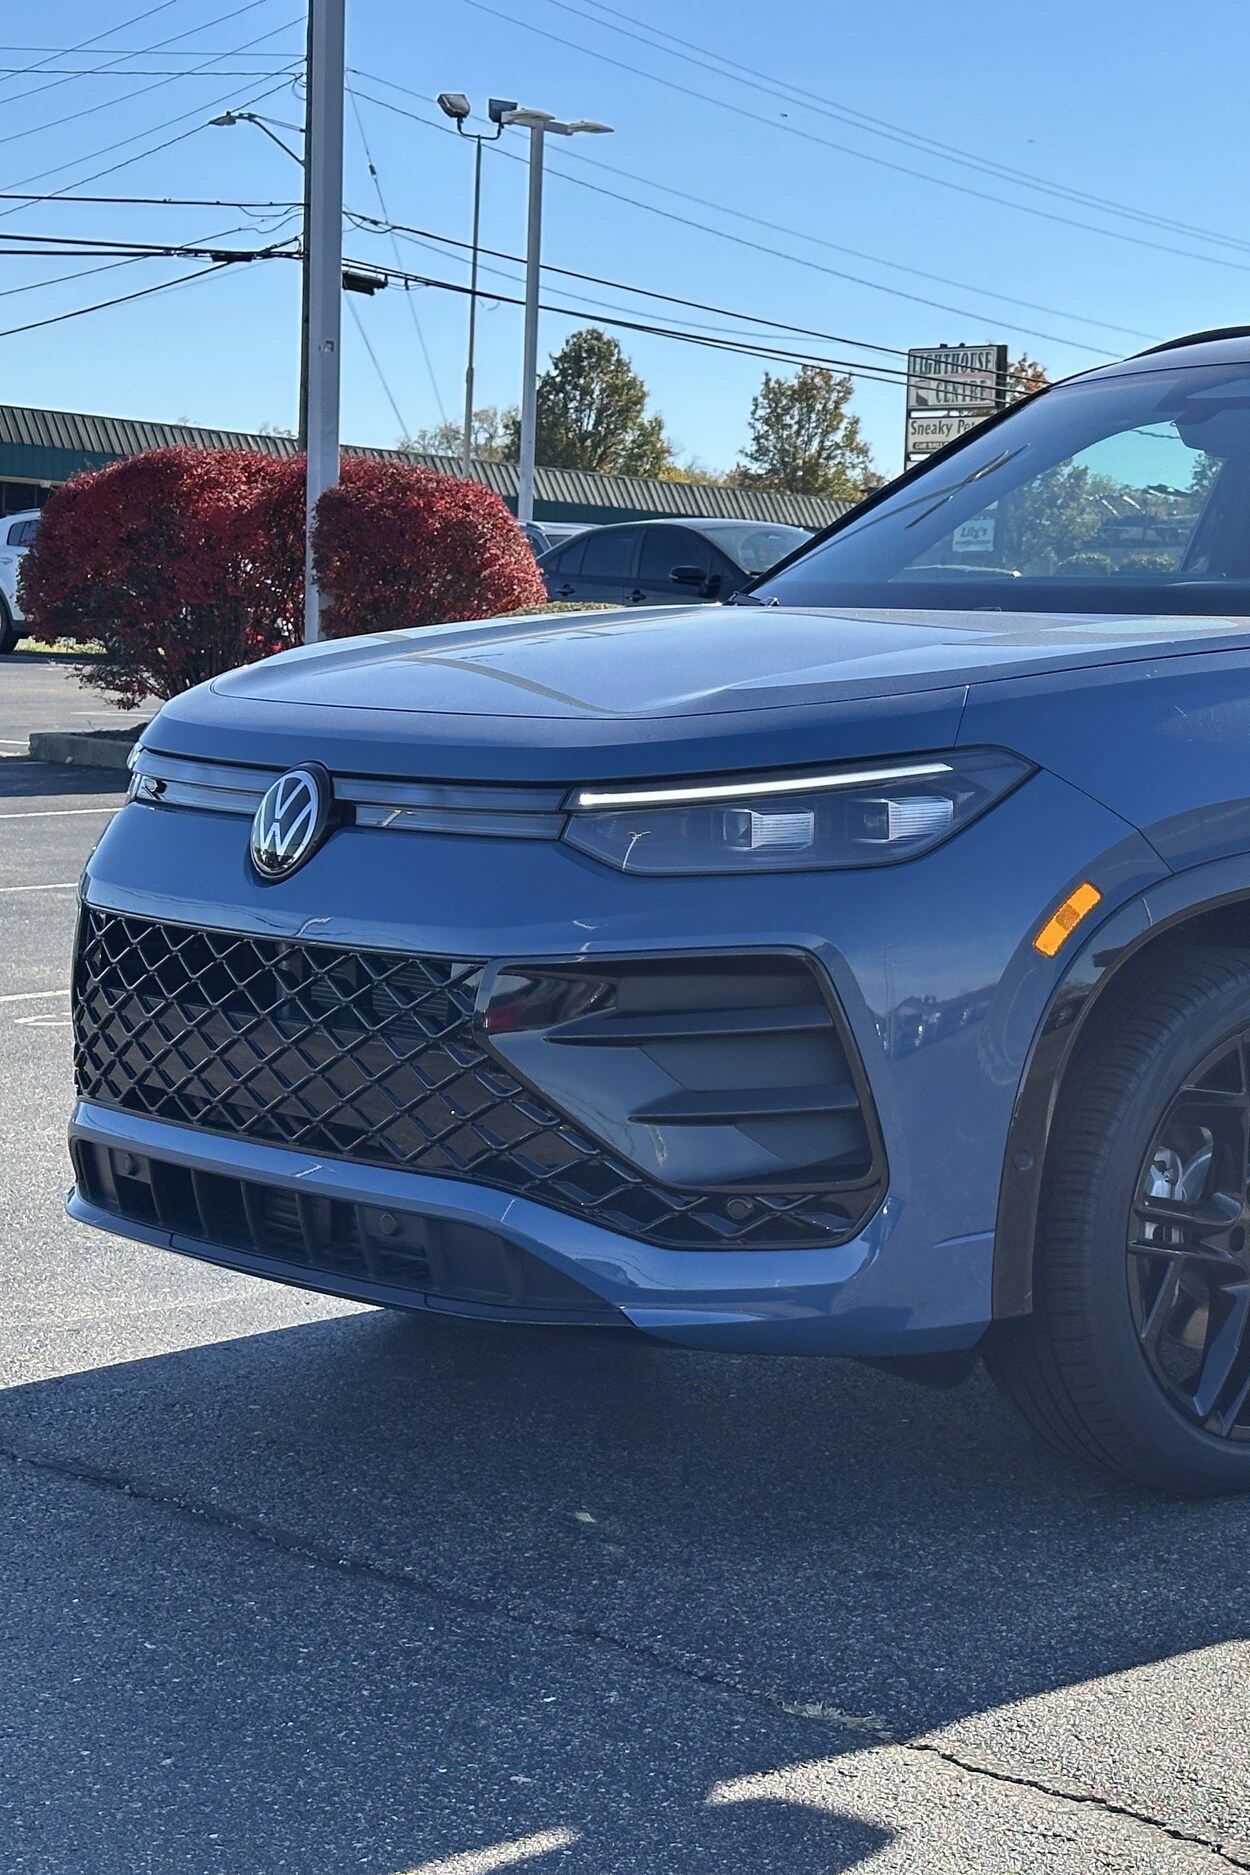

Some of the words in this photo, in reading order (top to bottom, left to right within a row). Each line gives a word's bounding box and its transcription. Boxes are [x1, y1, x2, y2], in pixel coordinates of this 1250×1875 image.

[912, 351, 992, 375] LIGHTHOUSE
[935, 380, 987, 403] CENTRE
[911, 420, 953, 437] Sneaky
